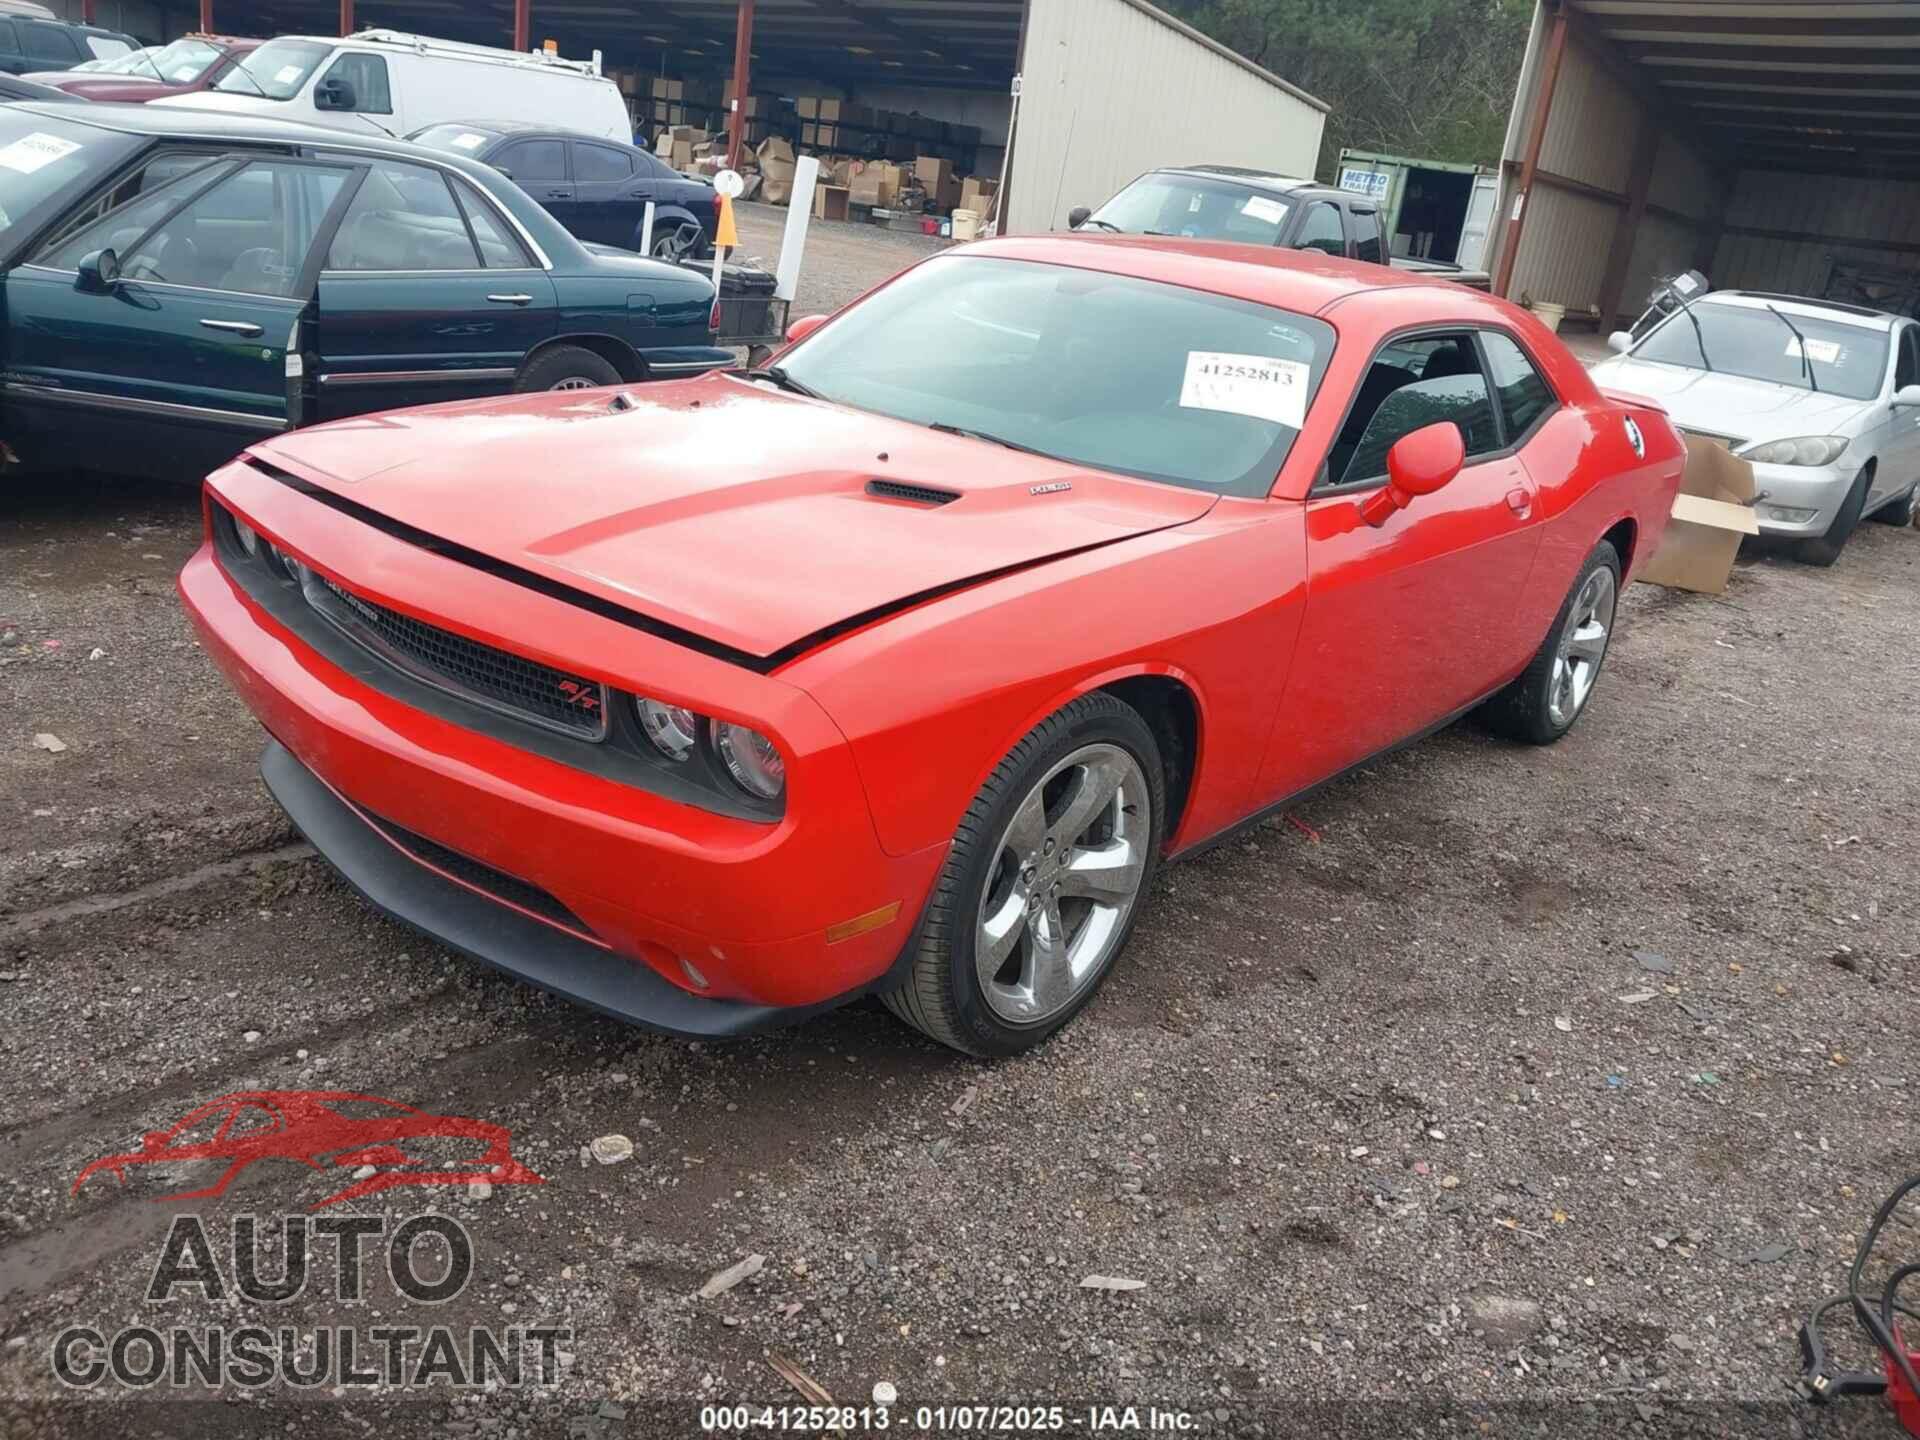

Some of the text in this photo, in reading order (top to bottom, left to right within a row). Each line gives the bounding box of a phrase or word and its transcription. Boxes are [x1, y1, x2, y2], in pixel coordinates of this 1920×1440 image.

[1345, 171, 1387, 185] METRO
[1198, 363, 1293, 386] 41252813
[559, 680, 600, 710] R/T
